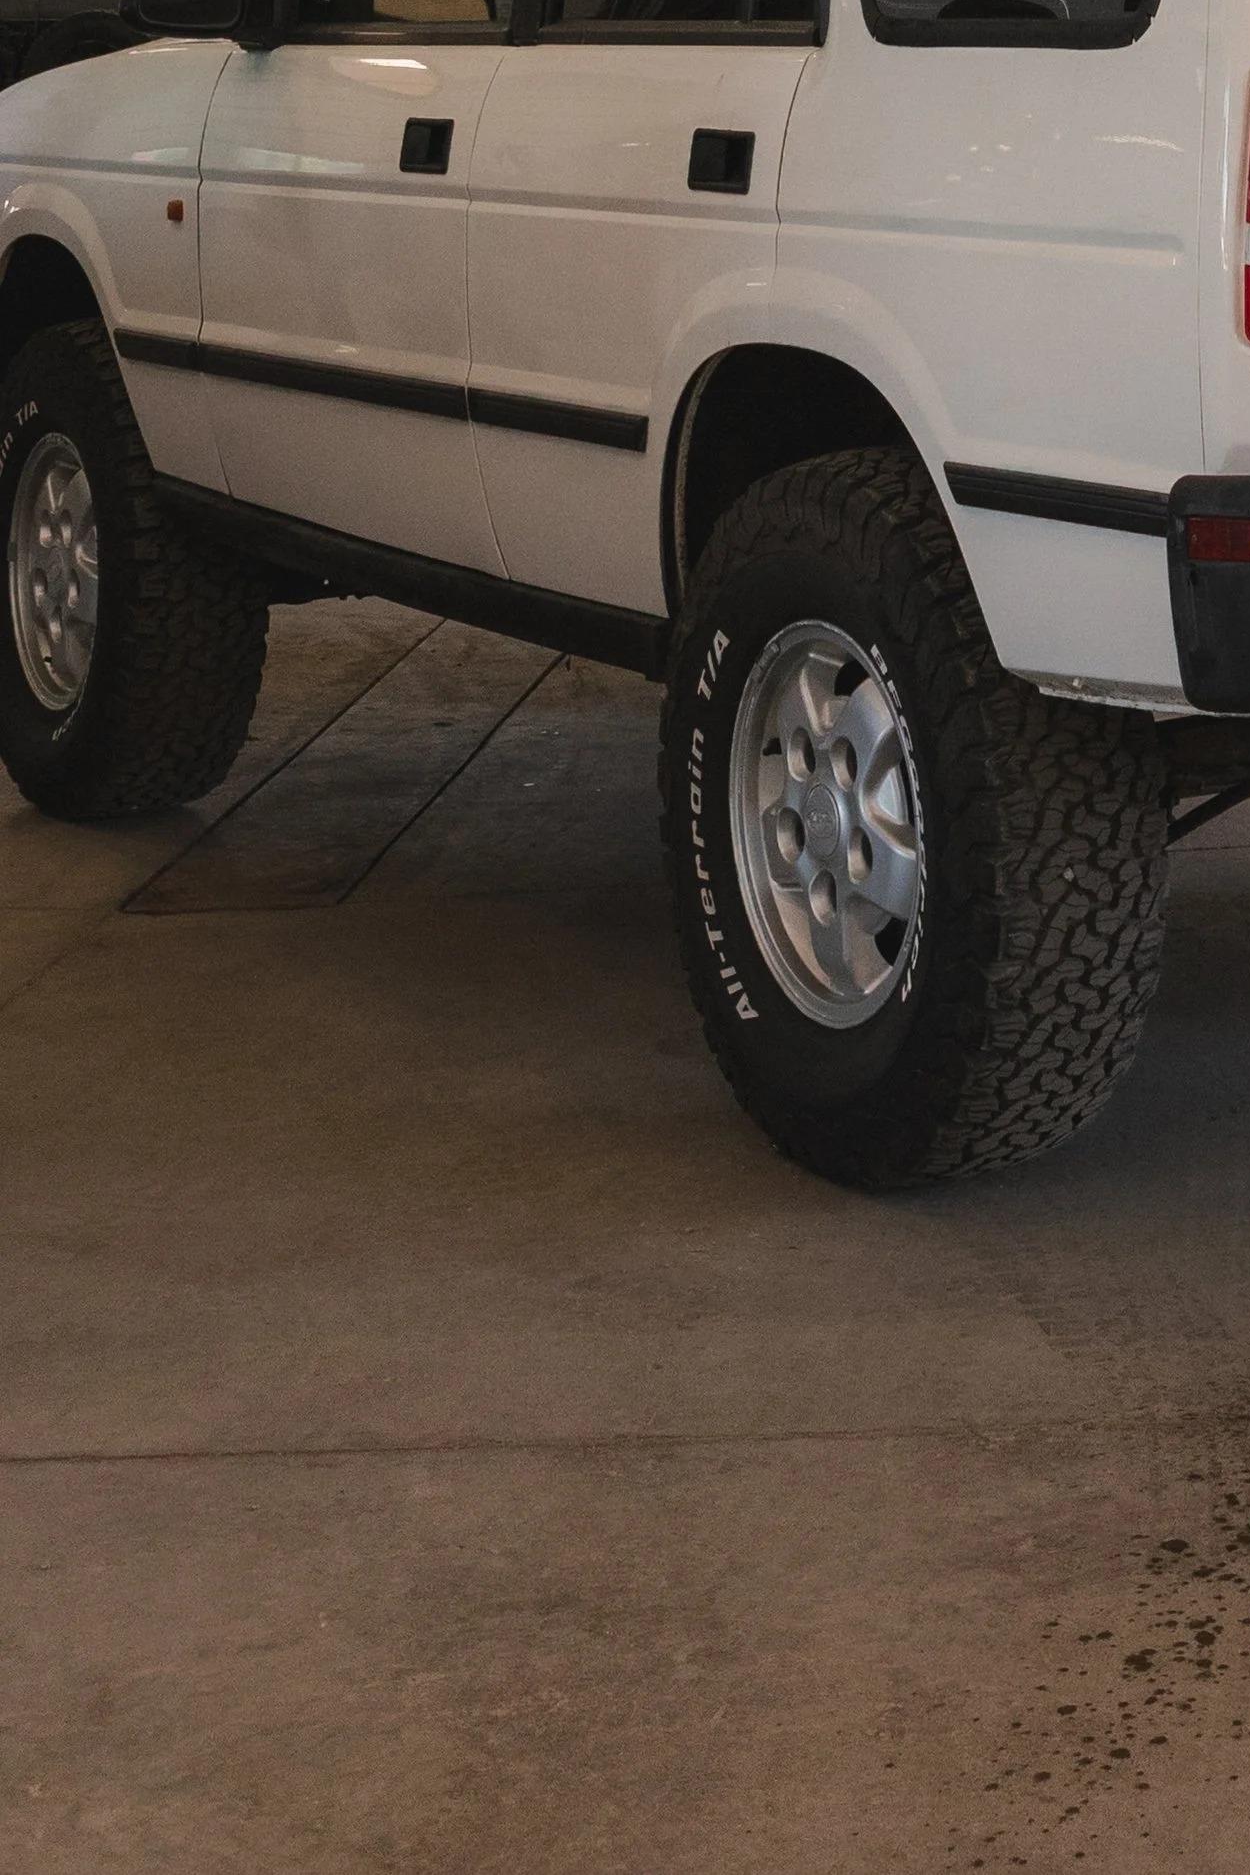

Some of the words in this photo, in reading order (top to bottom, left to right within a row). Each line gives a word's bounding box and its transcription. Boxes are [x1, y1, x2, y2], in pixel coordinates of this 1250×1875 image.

[16, 400, 39, 426] T/A
[697, 629, 731, 701] T/A
[687, 727, 760, 1020] All-Terrain
